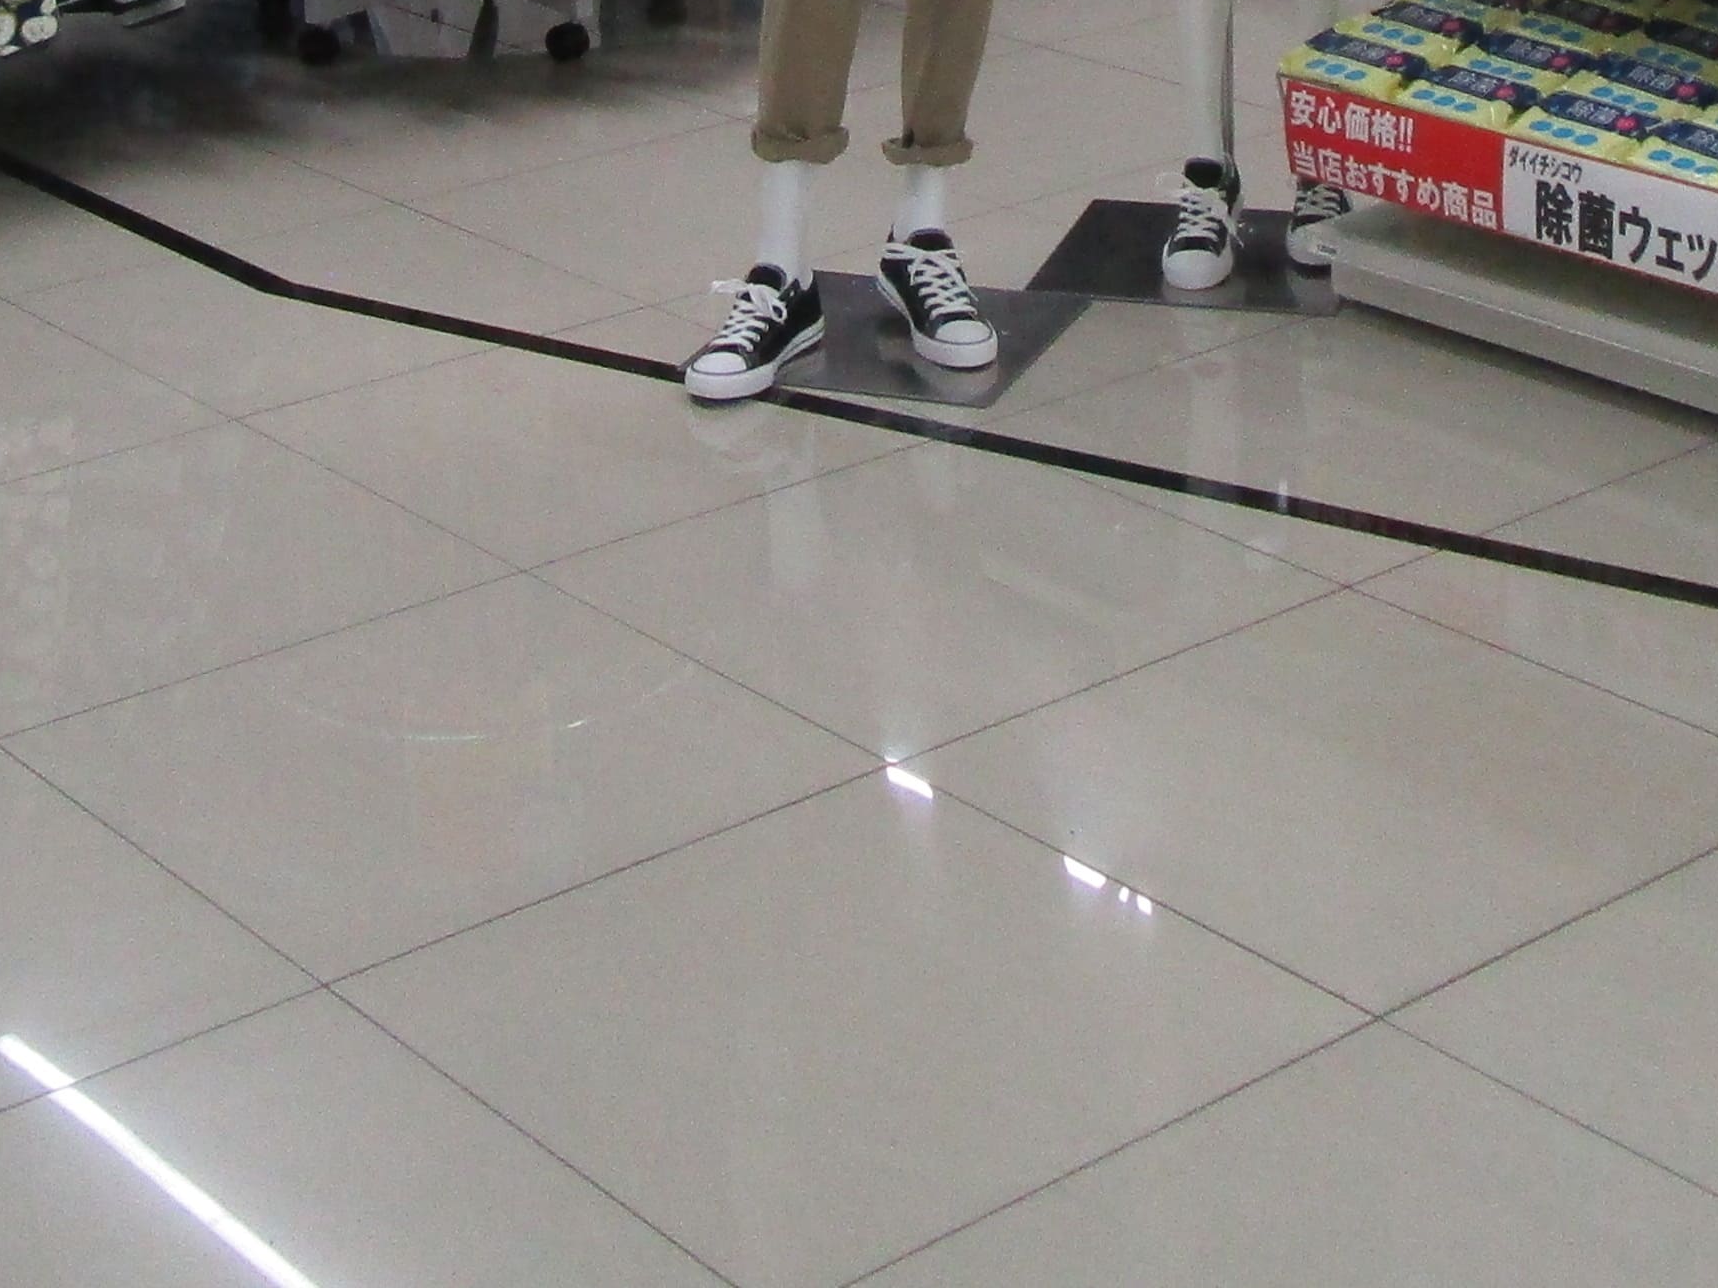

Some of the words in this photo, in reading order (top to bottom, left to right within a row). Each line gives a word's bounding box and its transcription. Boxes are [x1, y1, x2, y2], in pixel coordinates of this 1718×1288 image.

[1289, 89, 1415, 154] 安心価格!!
[1291, 141, 1499, 231] 当店おすすめ商品
[1508, 144, 1583, 184] ダイイチシコウ
